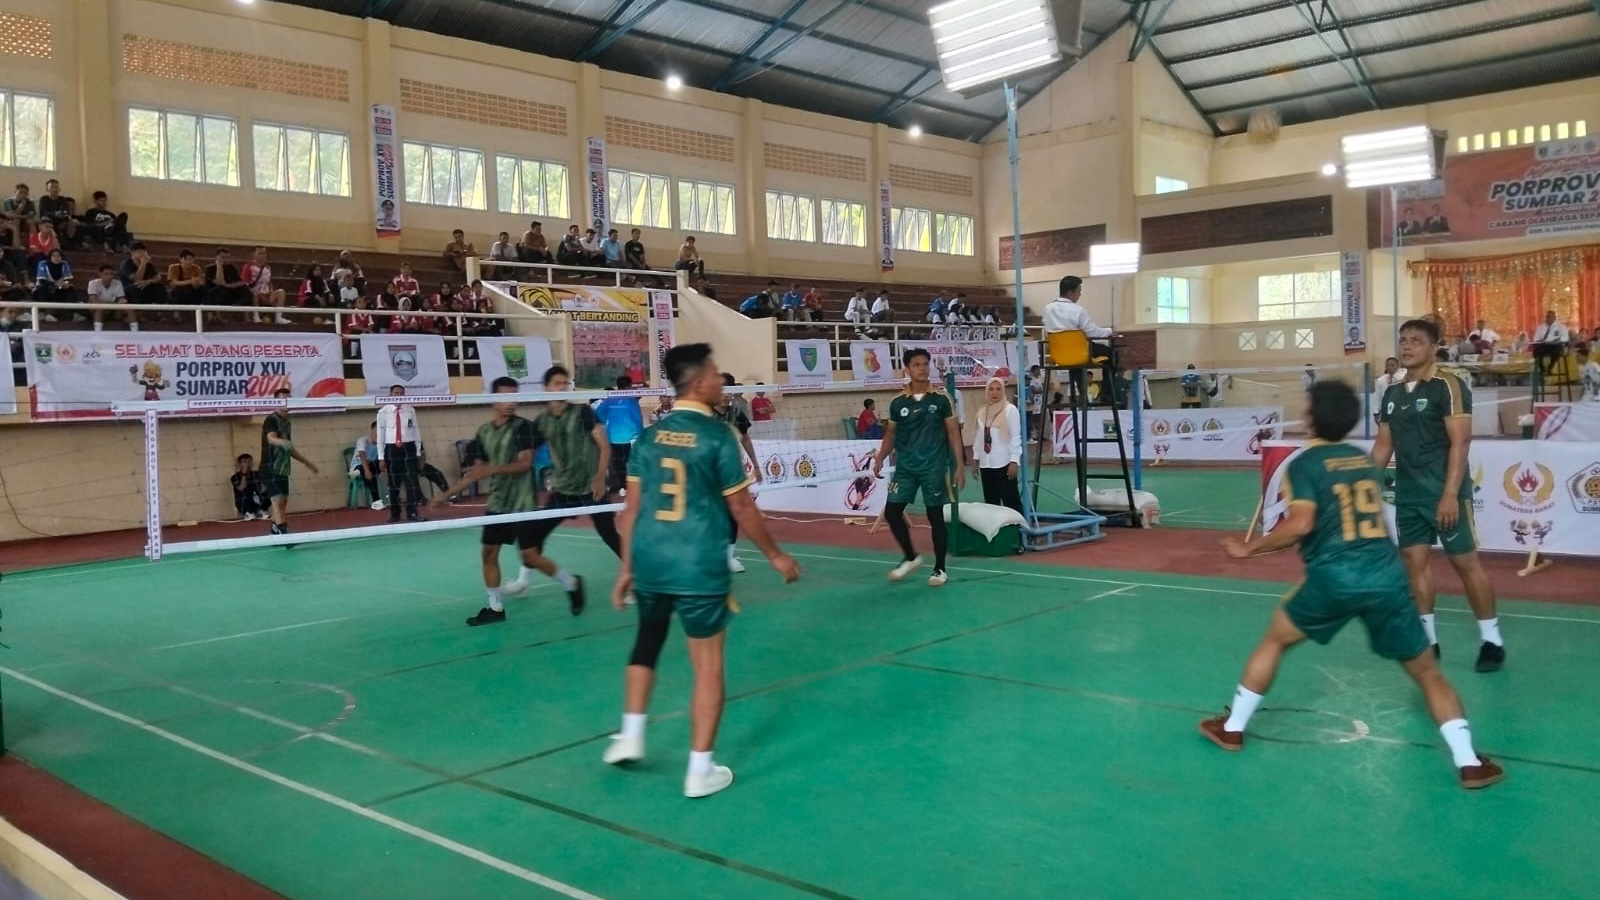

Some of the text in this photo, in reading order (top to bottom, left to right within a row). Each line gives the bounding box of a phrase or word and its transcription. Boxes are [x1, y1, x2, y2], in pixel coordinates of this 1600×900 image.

[377, 158, 386, 198] PORPROV
[386, 165, 394, 199] SUMBAR
[1490, 172, 1600, 200] PORPROV
[1505, 191, 1586, 211] SUMBAR
[580, 311, 639, 323] BERTANDING
[114, 344, 322, 358] SELAMAT DATANG PESERTA
[176, 361, 286, 378] PORPROV XVI
[176, 378, 249, 396] SUMBAR
[654, 457, 688, 522] 3
[1331, 479, 1389, 542] 19
